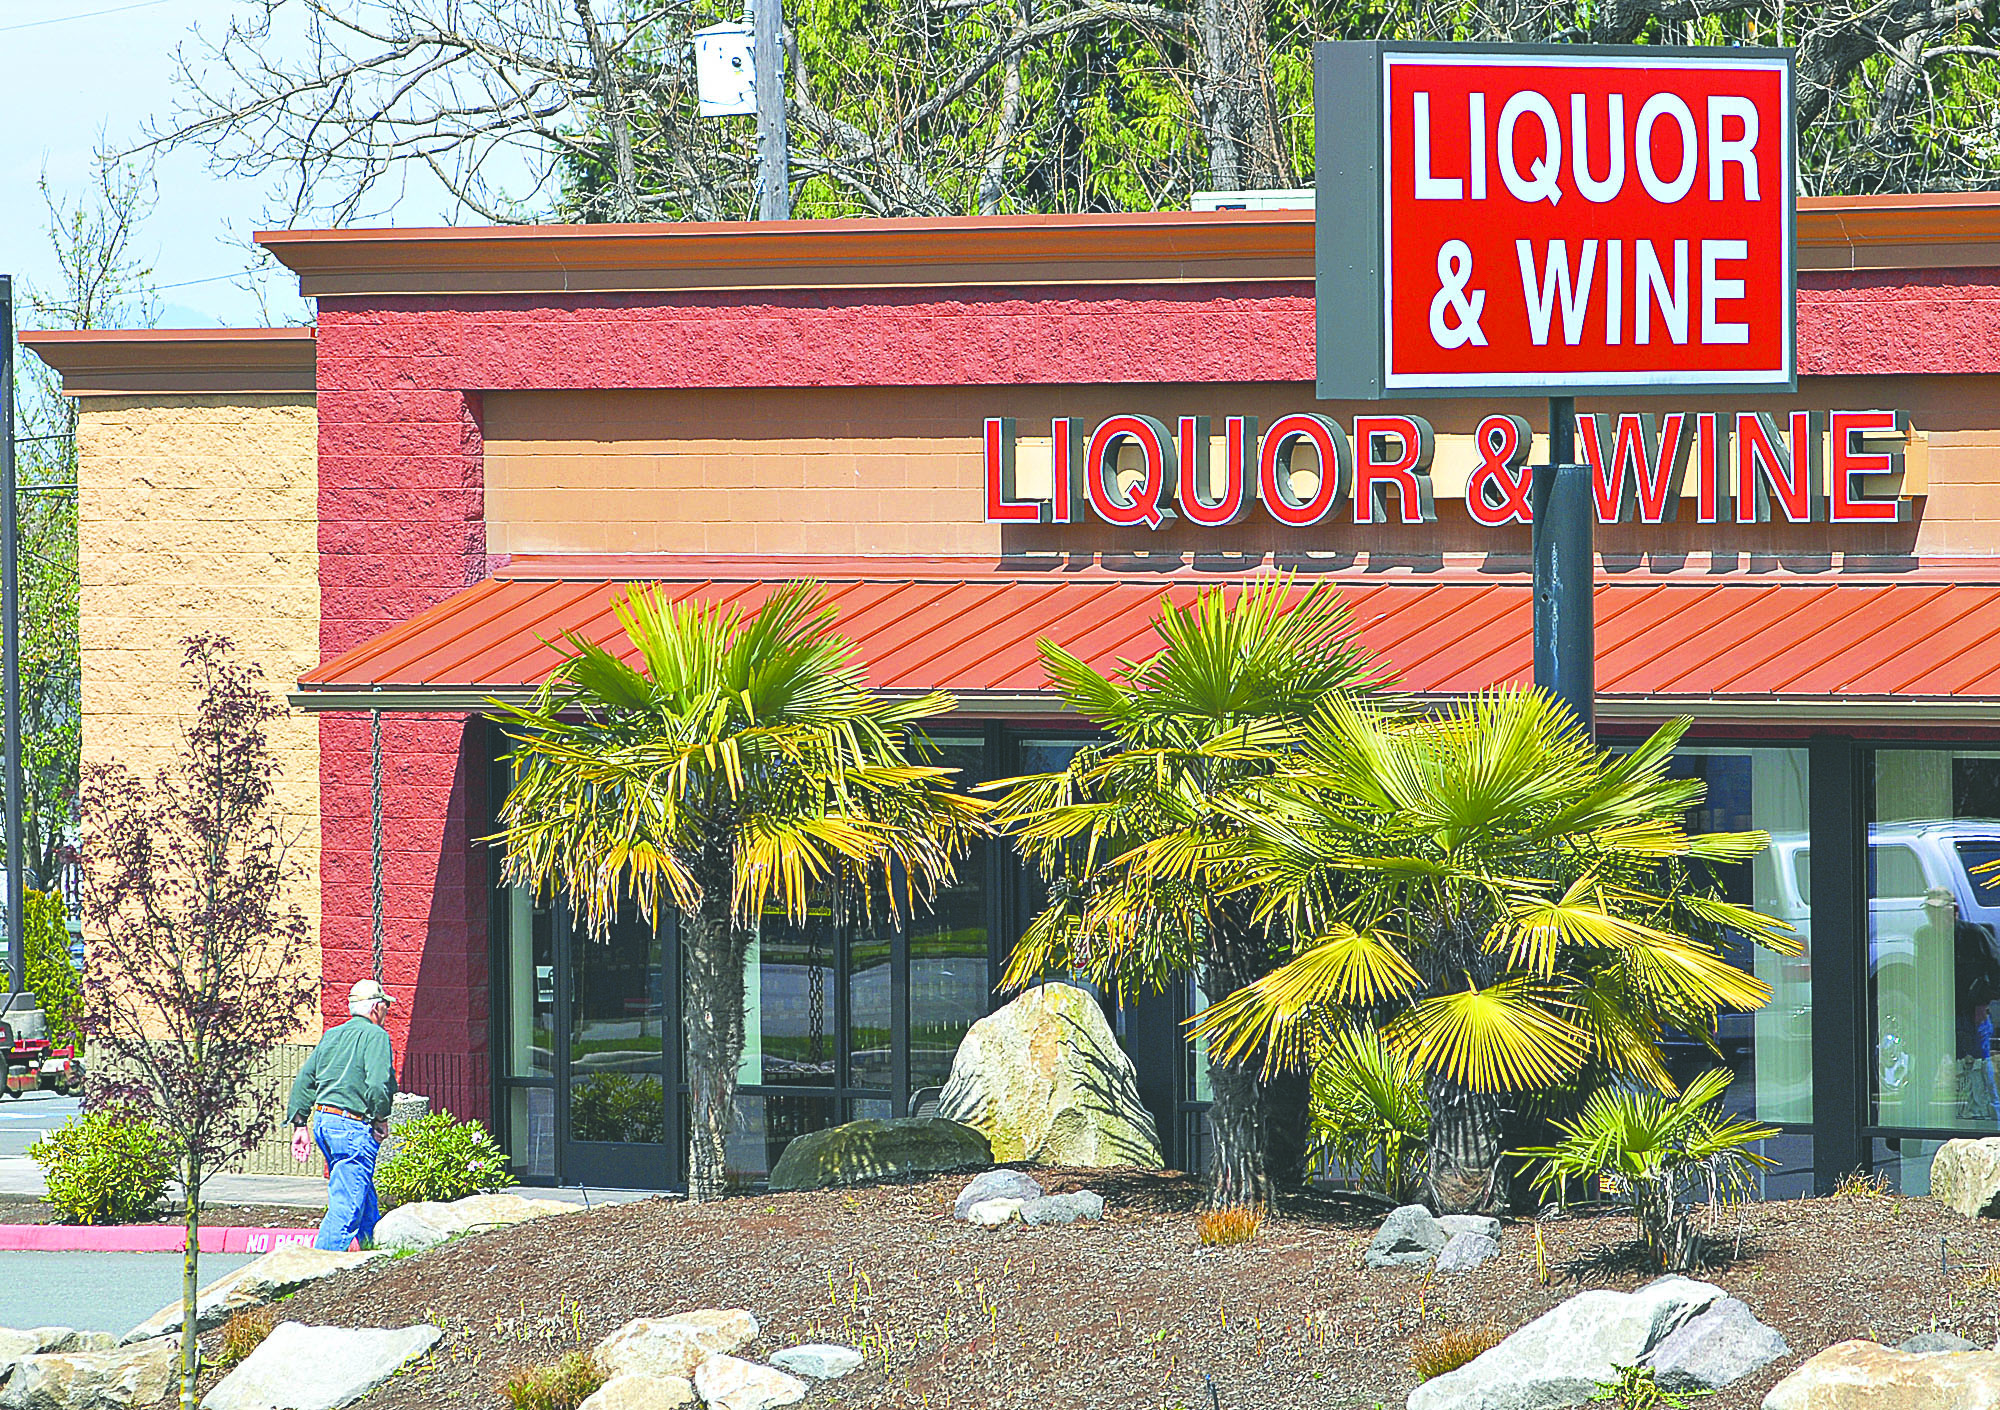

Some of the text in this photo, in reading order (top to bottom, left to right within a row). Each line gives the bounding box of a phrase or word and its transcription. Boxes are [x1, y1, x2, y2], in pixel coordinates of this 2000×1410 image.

[1413, 90, 1761, 206] LIQUOR
[1429, 239, 1750, 349] & WINE
[984, 410, 1901, 531] LIQUOR & WINE
[245, 1234, 270, 1253] NO
